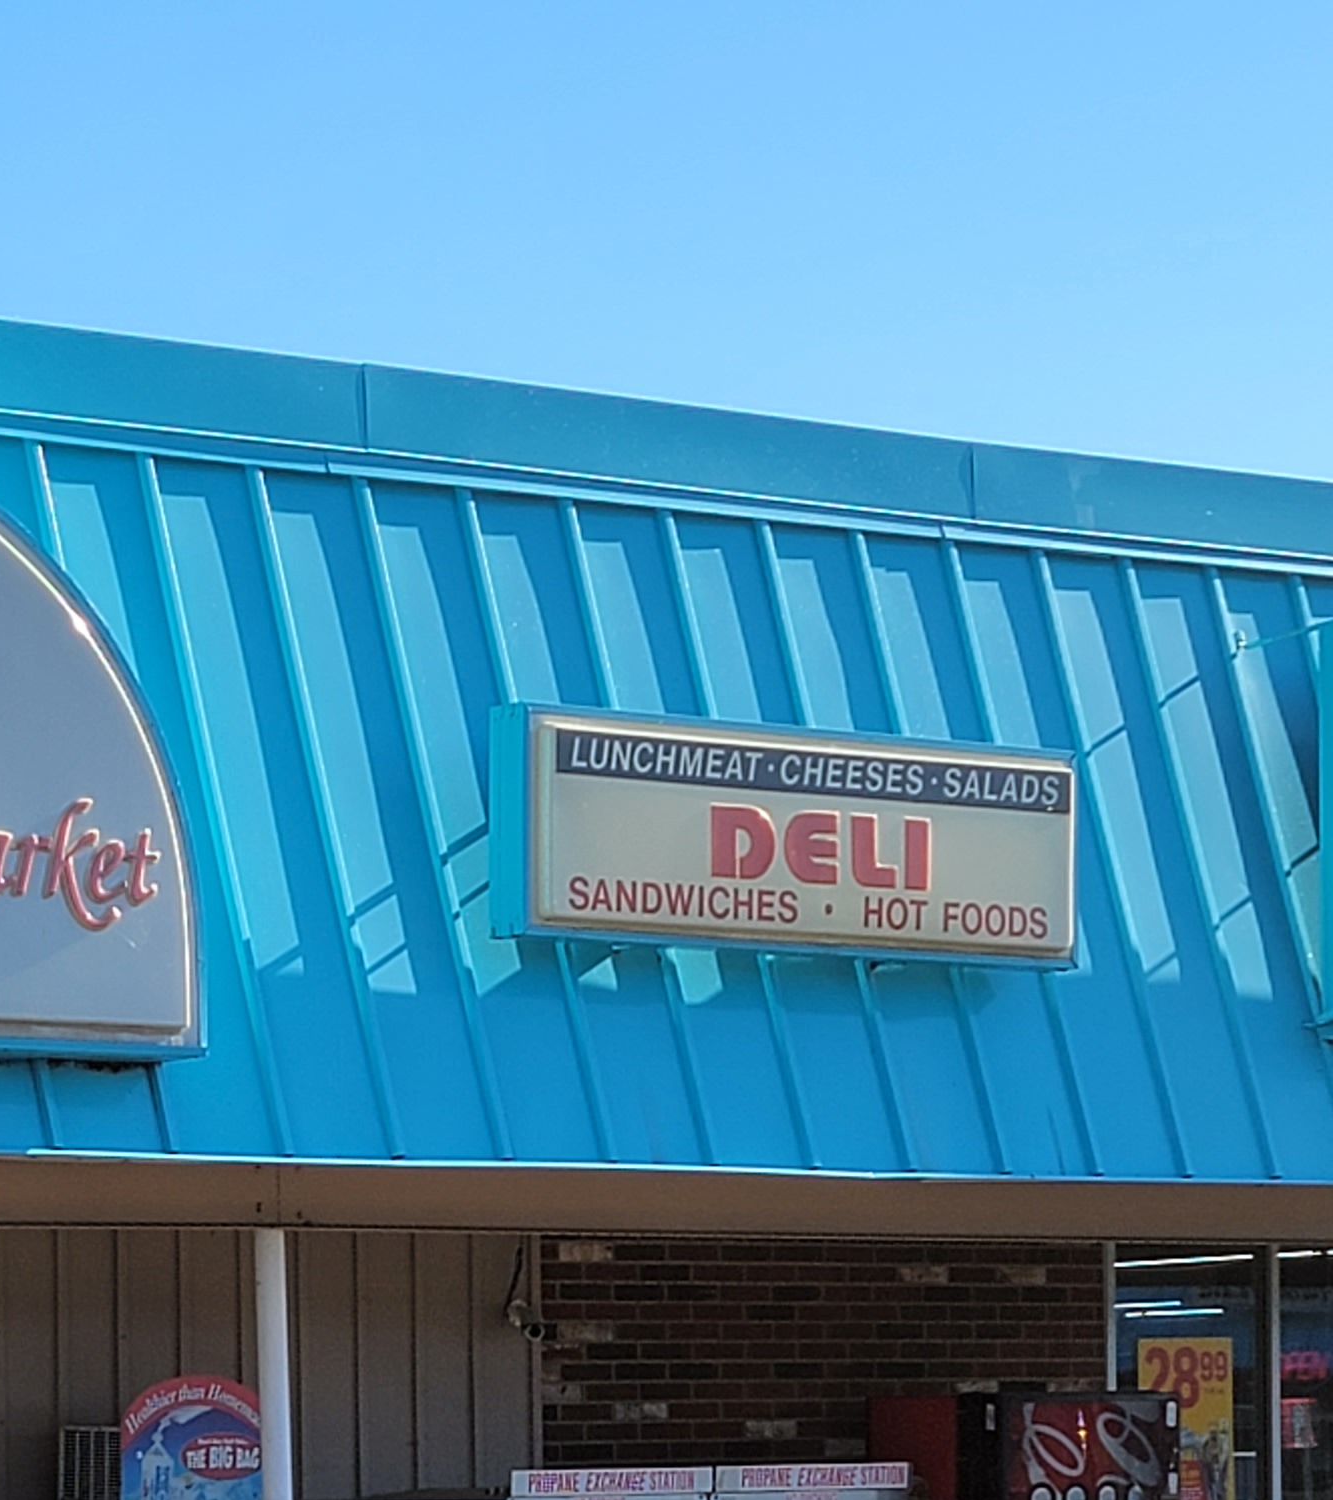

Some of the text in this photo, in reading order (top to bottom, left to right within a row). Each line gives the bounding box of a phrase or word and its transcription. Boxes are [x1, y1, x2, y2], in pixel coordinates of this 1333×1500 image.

[571, 737, 1060, 806] LUNCHMEAT CHEESES SALADS
[709, 802, 932, 892] DELI
[567, 877, 1049, 939] SANDWICHES HOT FOODS
[186, 1445, 260, 1469] THE BIG BAG
[742, 1465, 905, 1487] PROPANE EXCHANGE STATION
[528, 1470, 695, 1493] PROPANE EXCHANGE STATION
